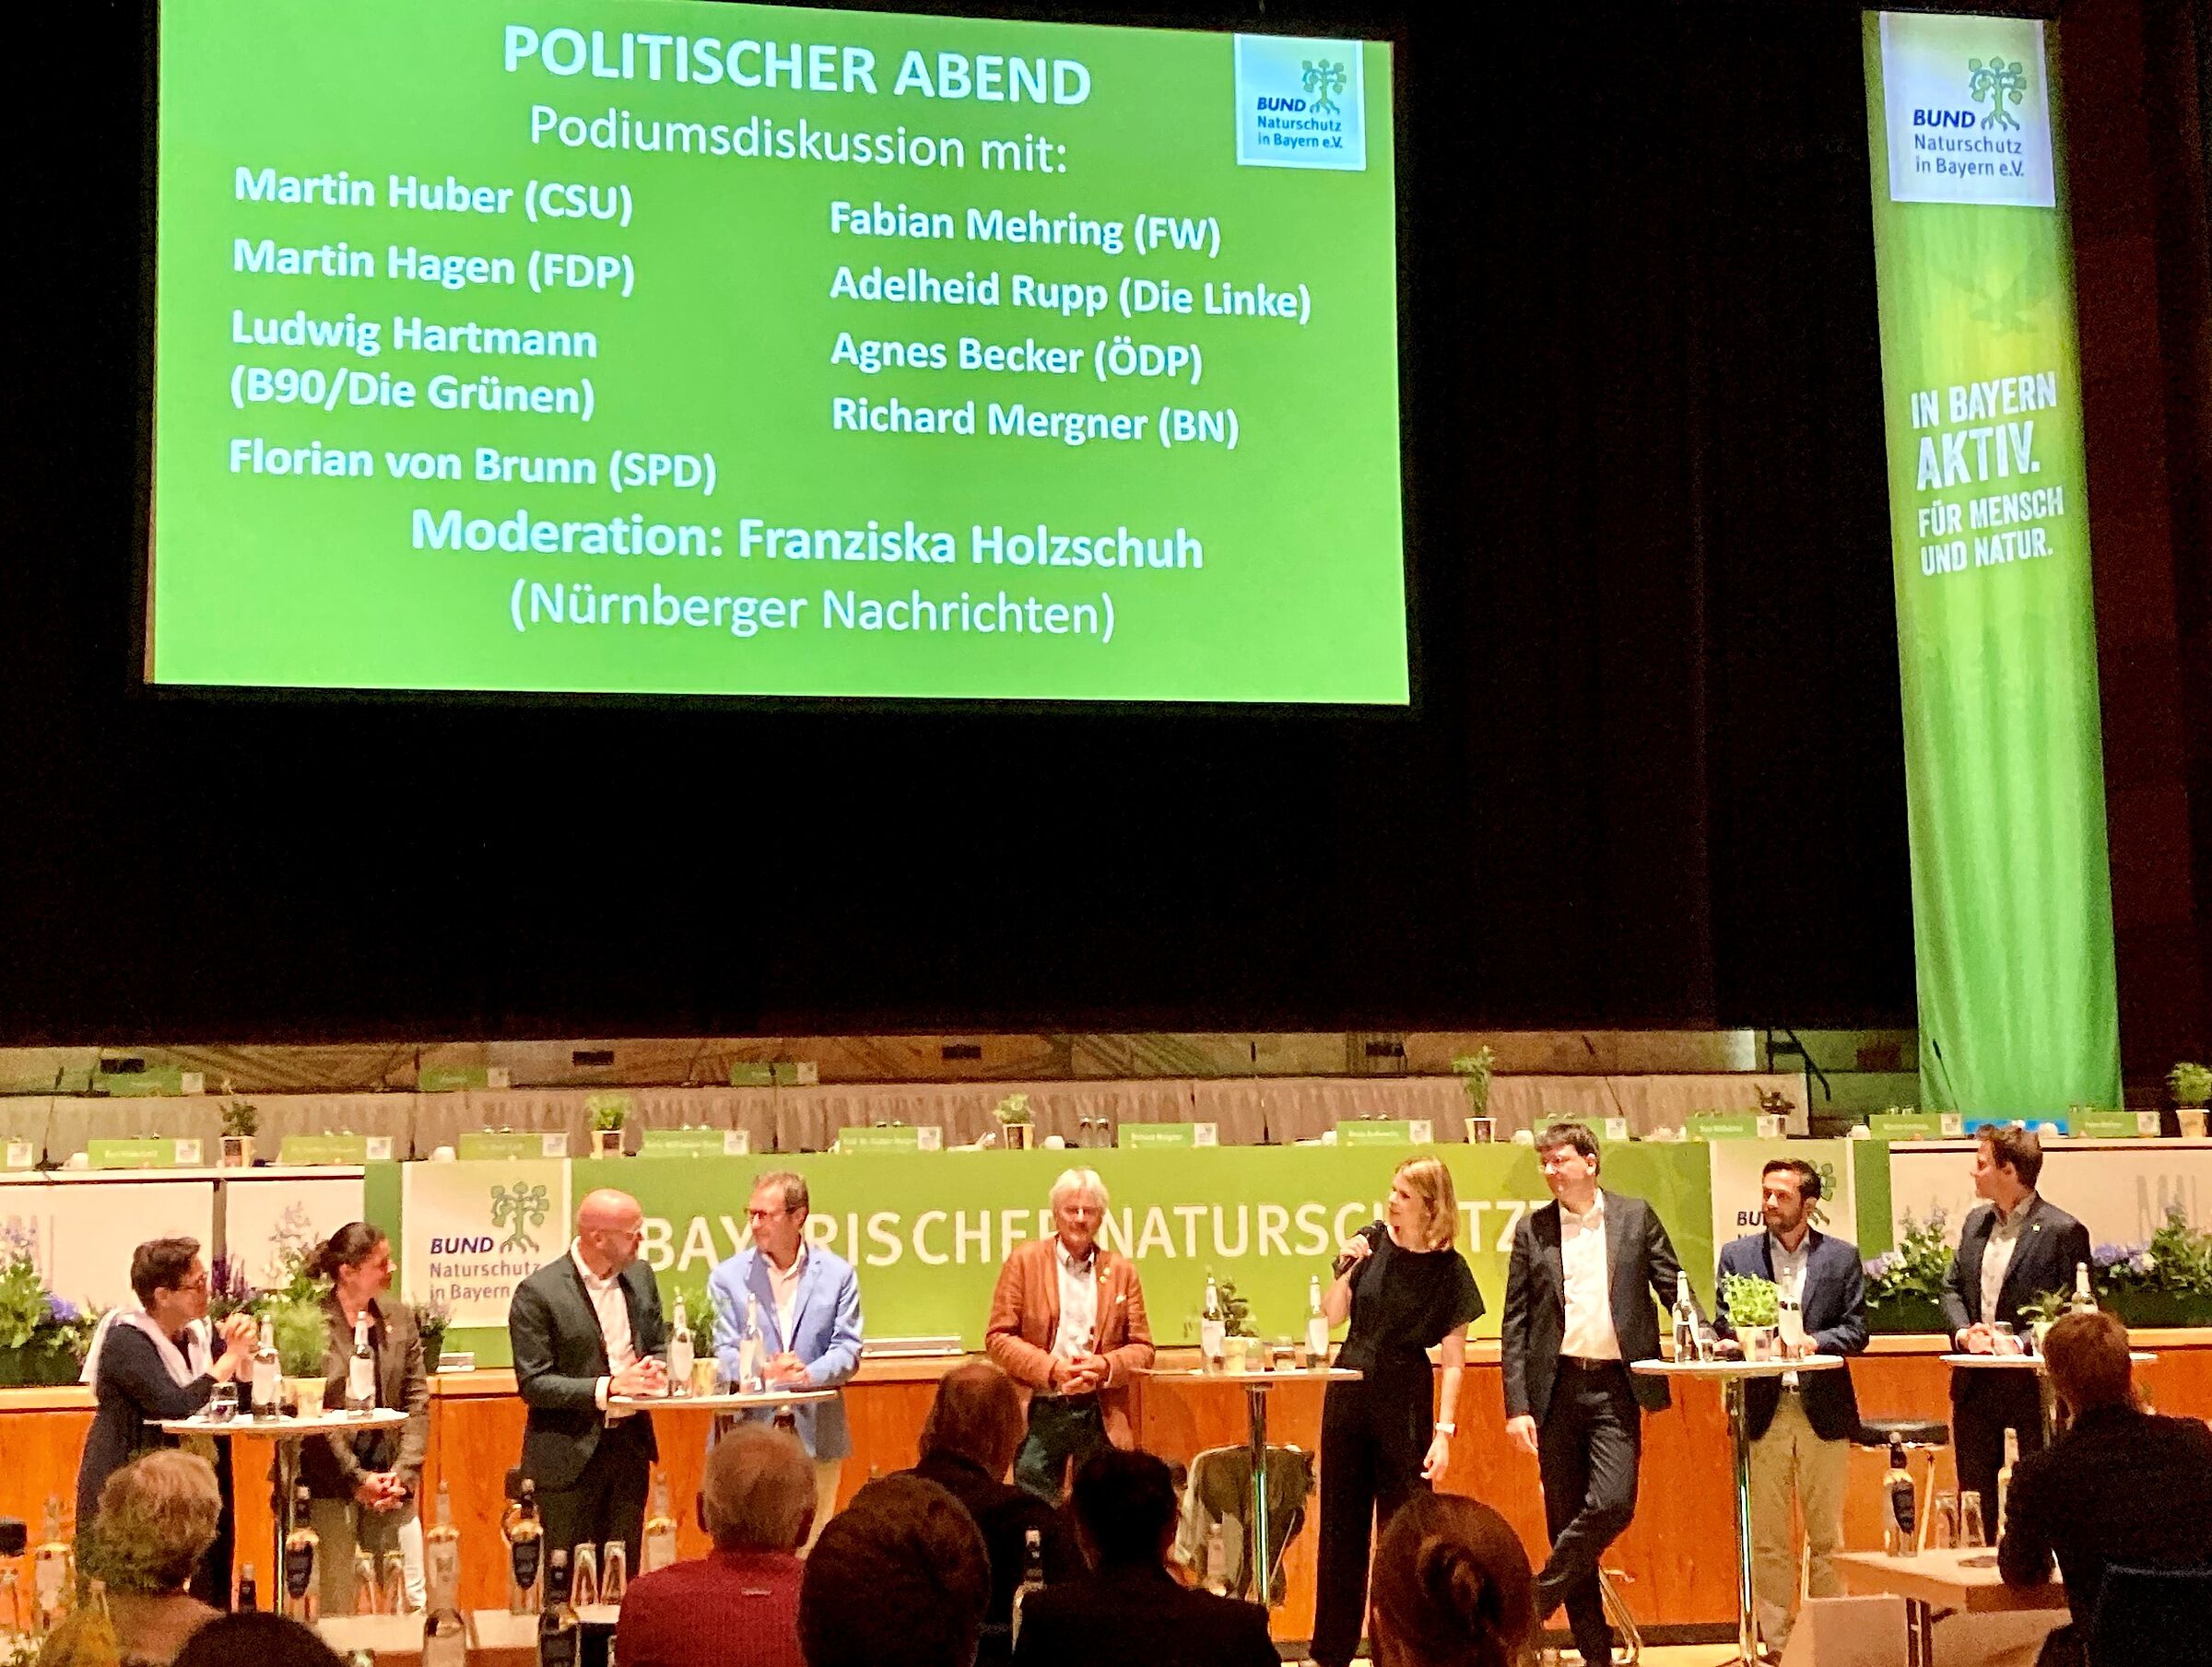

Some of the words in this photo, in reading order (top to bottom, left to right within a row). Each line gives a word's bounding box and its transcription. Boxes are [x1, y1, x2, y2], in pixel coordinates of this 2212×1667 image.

[504, 24, 878, 94] POLITISCHER
[893, 50, 1091, 105] ABEND
[1257, 97, 1306, 112] BUND
[1257, 115, 1342, 133] Naturschutz
[1912, 109, 1976, 129] BUND
[531, 104, 965, 168] Podiumsdiskussion
[982, 133, 1066, 173] mit:
[1258, 133, 1270, 146] in
[1274, 134, 1319, 149] Bayern
[1322, 137, 1343, 149] e.V.
[1914, 134, 2022, 155] Naturschutz
[1916, 156, 1931, 173] in
[1936, 158, 1994, 179] Bayern
[1999, 161, 2025, 178] e.V.
[234, 166, 375, 207] Martin
[388, 174, 514, 214] Huber
[524, 180, 633, 228] (CSU)
[830, 201, 955, 239] Fabian
[967, 207, 1124, 255] Mehring
[1134, 213, 1221, 259] (FW)
[233, 238, 375, 278] Martin
[387, 245, 515, 290] Hagen
[527, 250, 635, 298] (FDP)
[830, 265, 1000, 306] Adelheid
[1012, 274, 1109, 317] Rupp
[1119, 276, 1194, 319] (Die
[1204, 282, 1312, 325] Linke)
[231, 309, 382, 358] Ludwig
[393, 315, 597, 358] Hartmann
[830, 332, 947, 374] Agnes
[959, 336, 1085, 374] Becker
[1094, 335, 1203, 385] (ÖDP)
[229, 364, 417, 412] (B90/Die
[427, 374, 595, 422] Grünen)
[1911, 389, 1939, 429] IN
[1948, 370, 2057, 424] BAYERN
[832, 397, 975, 435] Richard
[988, 403, 1149, 446] Mergner
[1159, 406, 1240, 451] (BN)
[229, 437, 374, 477] Florian
[384, 452, 462, 480] von
[475, 447, 597, 485] Brunn
[608, 450, 717, 497] (SPD)
[1916, 420, 2041, 491] AKTIV.
[411, 508, 723, 558] Moderation:
[739, 518, 956, 564] Franziska
[971, 523, 1204, 569] Holzschuh
[1918, 499, 1962, 538] FÜR
[1969, 486, 2065, 531] MENSCH
[1921, 540, 1969, 577] UND
[1974, 527, 2054, 568] NATUR.
[510, 578, 808, 638] (Nürnberger
[823, 589, 1115, 644] Nachrichten)
[430, 1237, 494, 1254] BUND
[638, 1208, 1057, 1272] BAYRISCHE
[451, 1283, 511, 1302] Bayern
